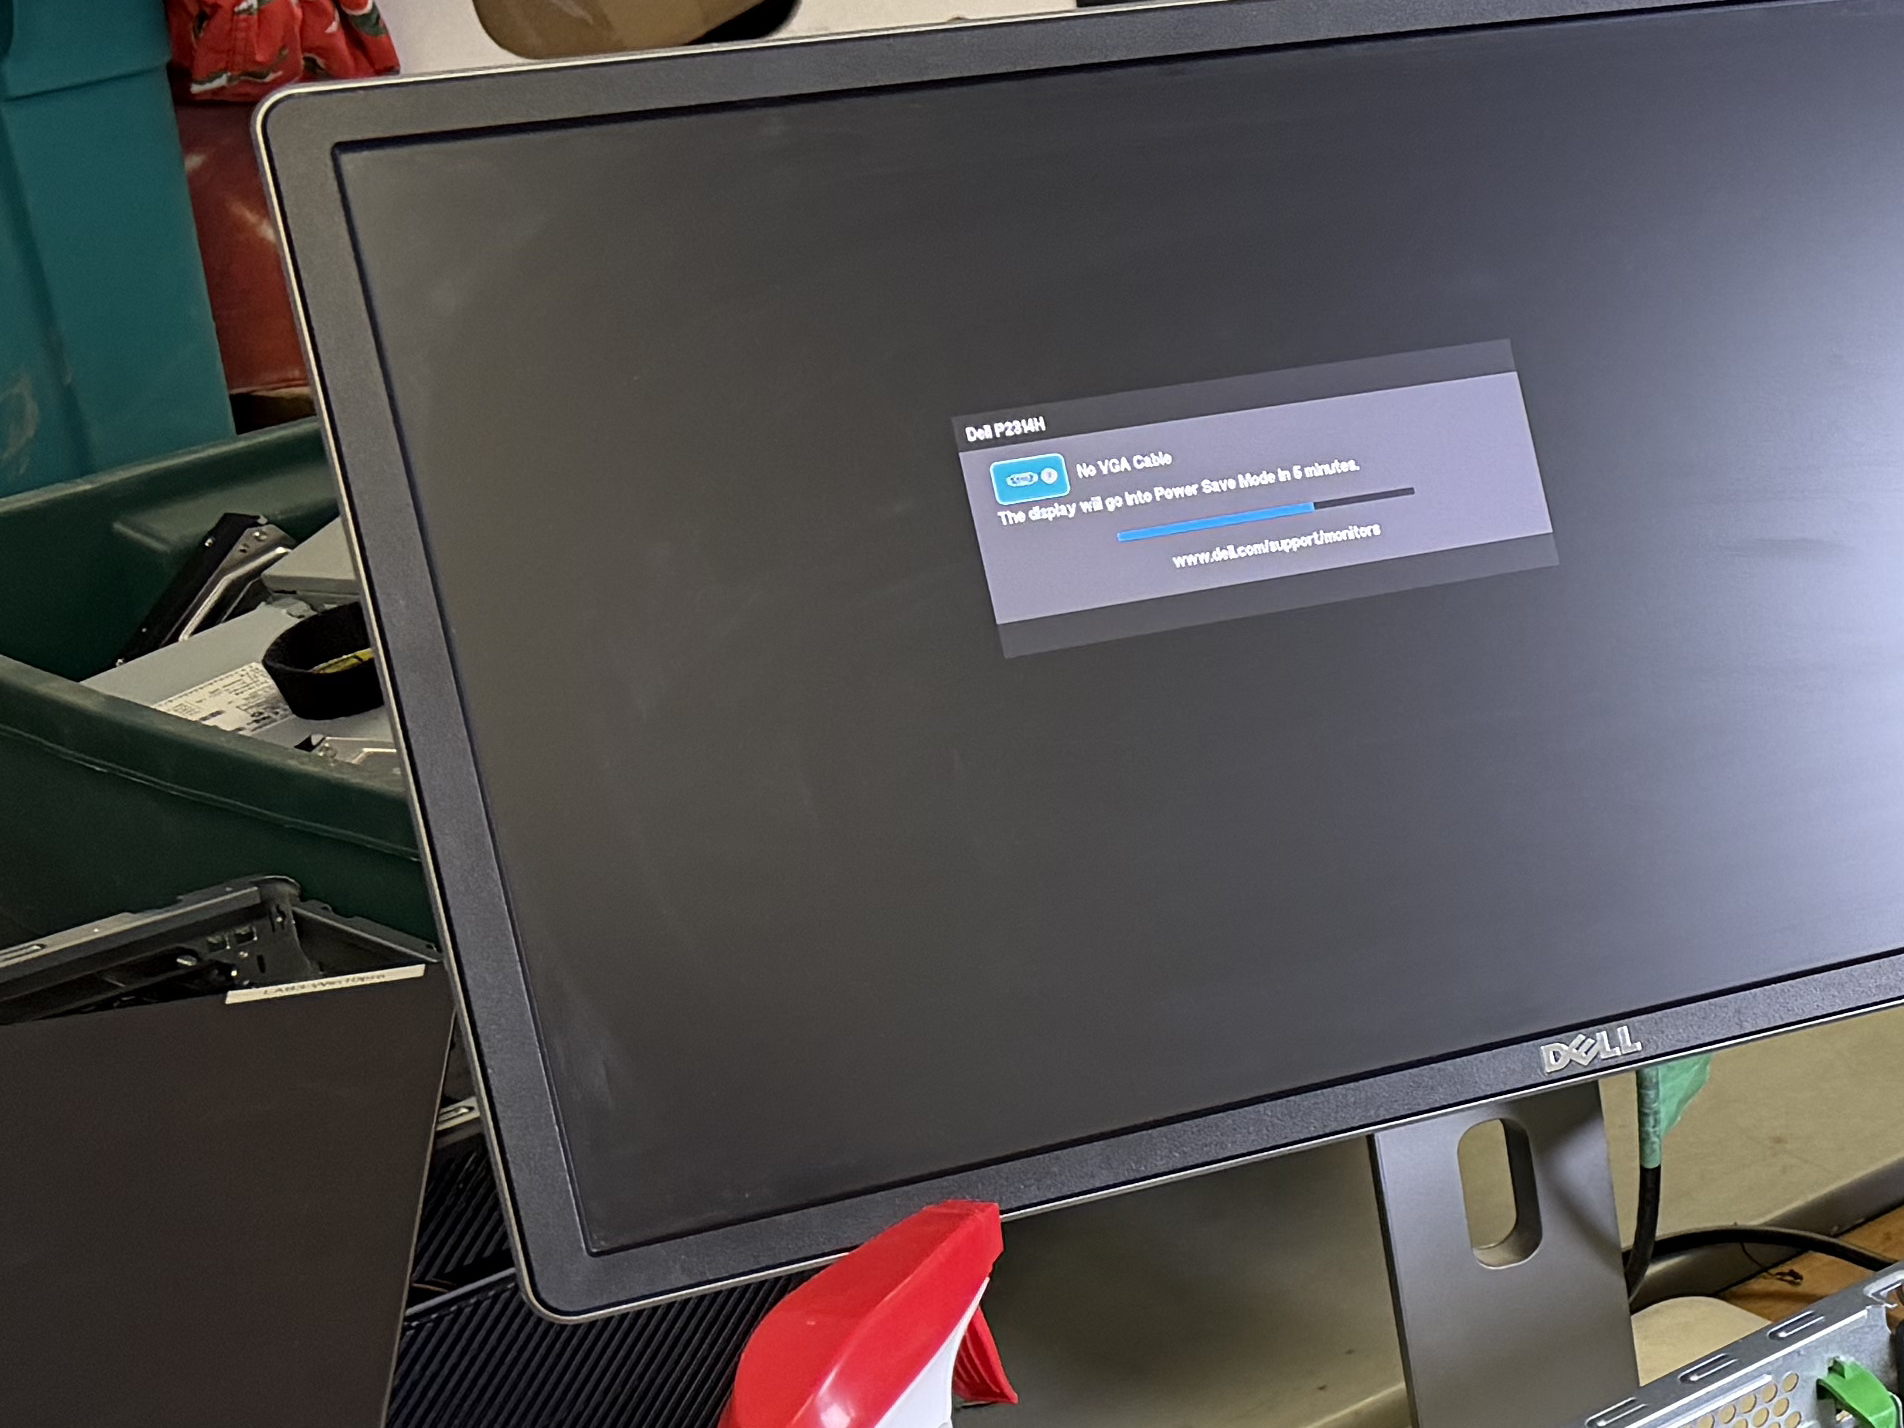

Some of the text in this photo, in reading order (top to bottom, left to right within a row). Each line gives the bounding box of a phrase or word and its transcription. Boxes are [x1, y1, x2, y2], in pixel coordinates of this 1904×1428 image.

[965, 416, 1046, 442] Dell P2314H
[1076, 451, 1173, 479] No VGA Cable
[997, 458, 1361, 526] The display will go into Power Save Mode in 5 minutes.
[1172, 522, 1382, 569] www.dell.com/support/monitors
[1540, 1025, 1643, 1073] DELL
